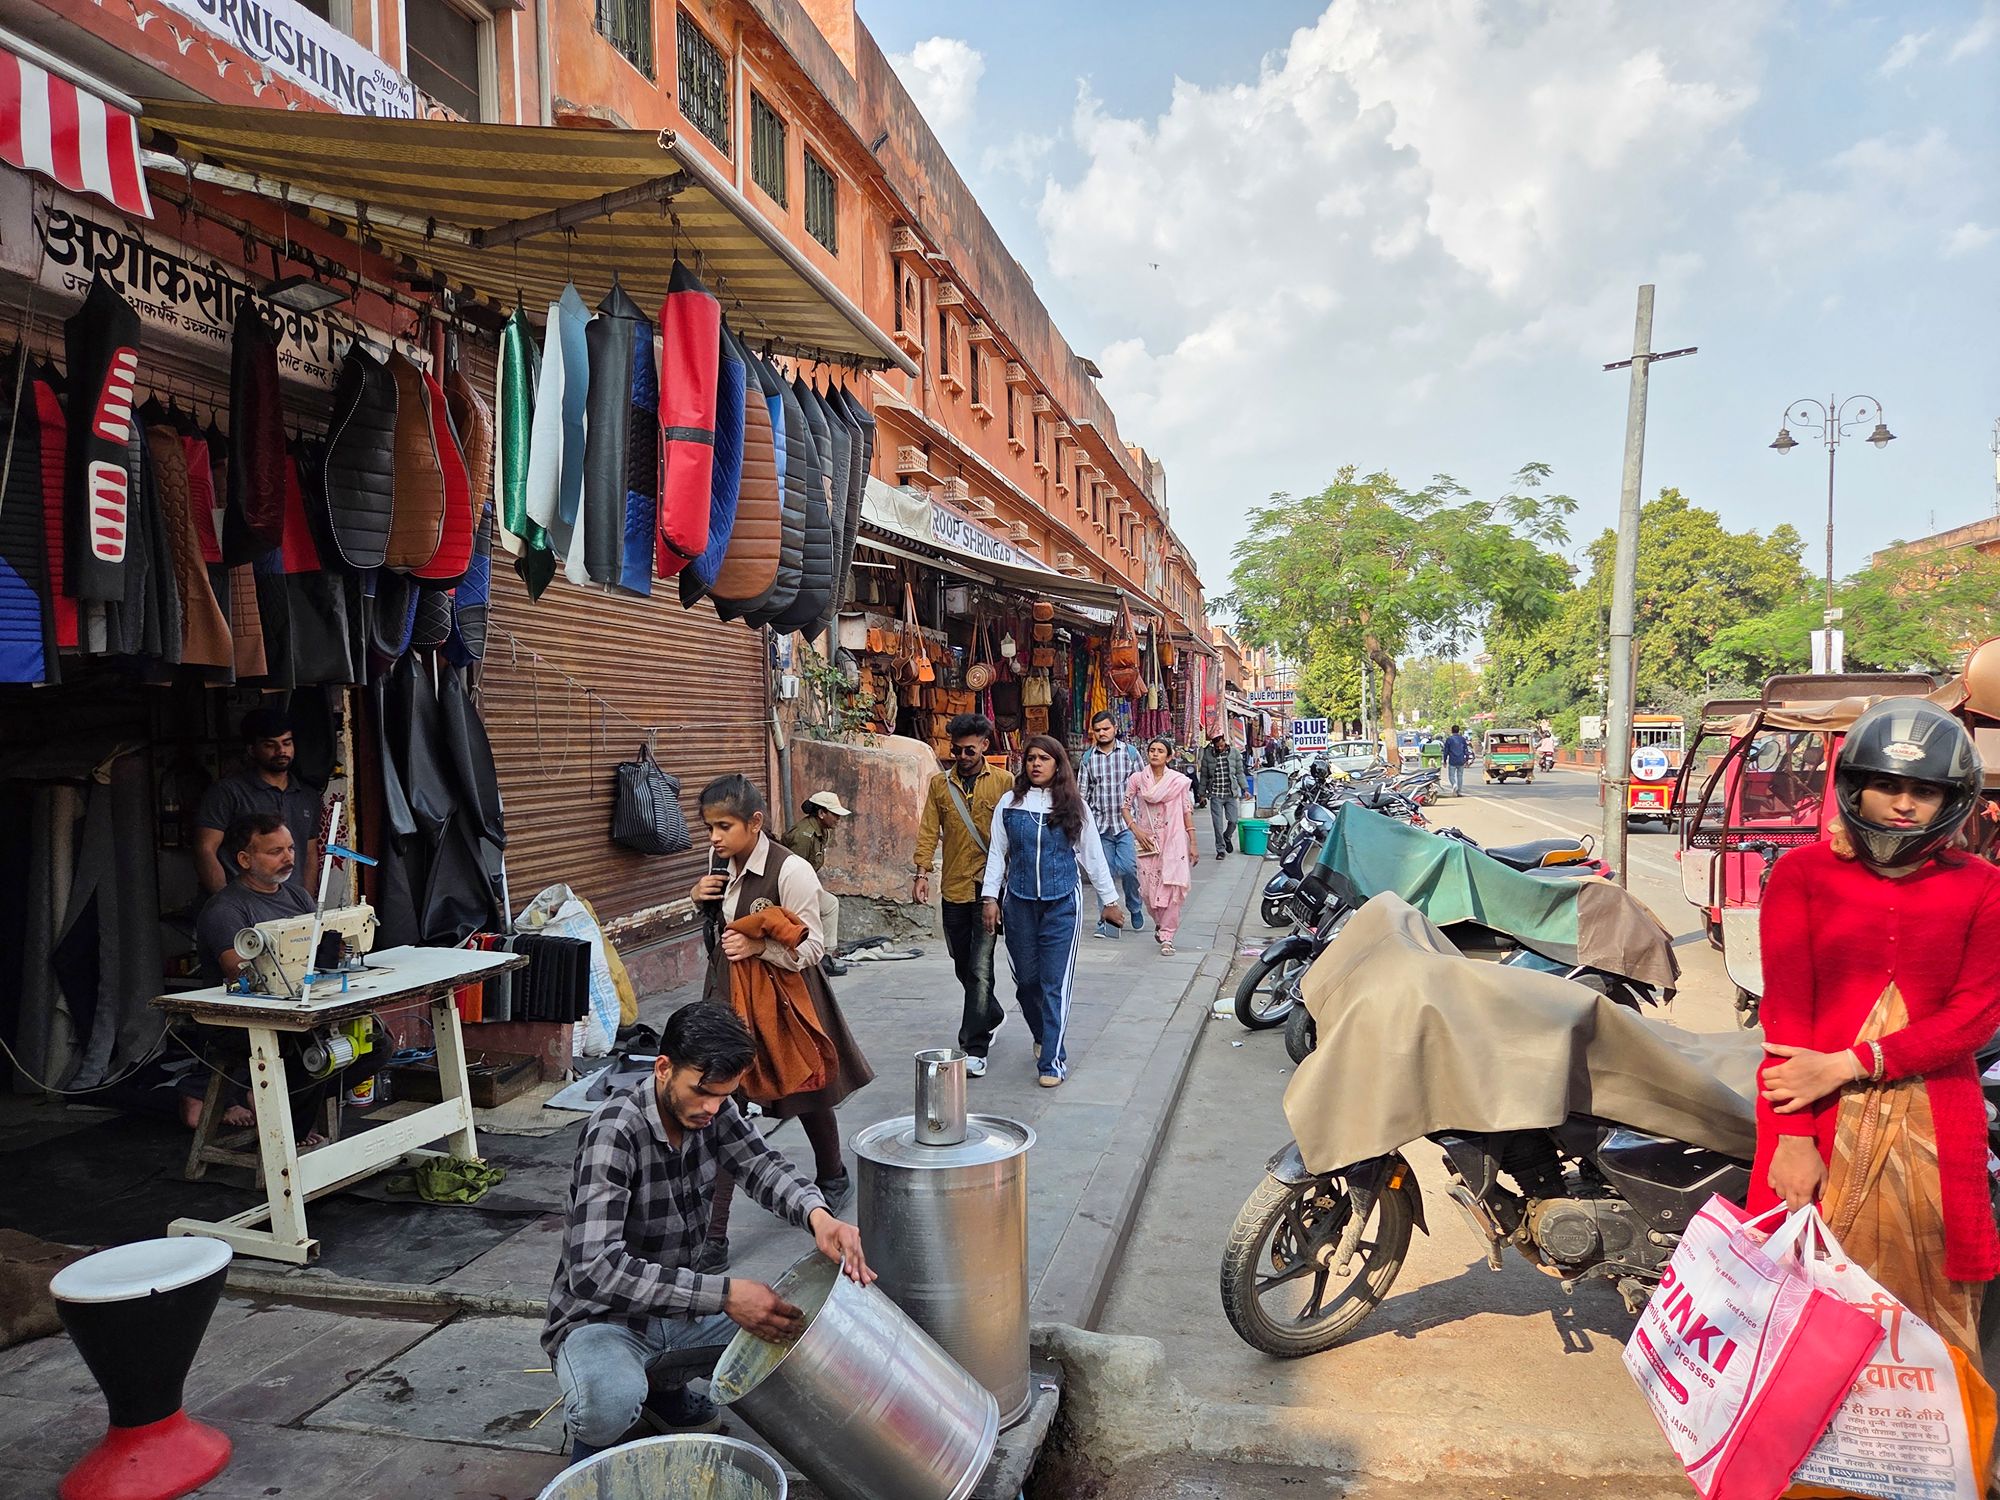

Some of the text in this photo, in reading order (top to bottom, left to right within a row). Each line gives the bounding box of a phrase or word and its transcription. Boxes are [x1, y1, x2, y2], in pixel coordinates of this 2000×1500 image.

[200, 0, 376, 116] RNISHING
[372, 69, 398, 95] Shop
[63, 271, 93, 297] उत्त
[279, 348, 303, 372] सीट
[932, 506, 961, 541] ROOP
[962, 526, 1011, 563] SHRINGAR
[1249, 691, 1293, 700] BLUE POTTERY
[1294, 720, 1327, 735] BLUE
[1294, 736, 1327, 745] POTTERY
[1659, 1264, 1738, 1374] PINKI
[1724, 1297, 1757, 1329] Fixed Price
[1648, 1301, 1716, 1388] amily Wear Dresses
[1868, 1407, 1891, 1417] छत
[1895, 1406, 1912, 1420] के
[1916, 1408, 1945, 1422] नीचे
[1670, 1416, 1698, 1445] JAIPUR
[1800, 1464, 1826, 1474] ockist
[1832, 1467, 1887, 1482] Raymond
